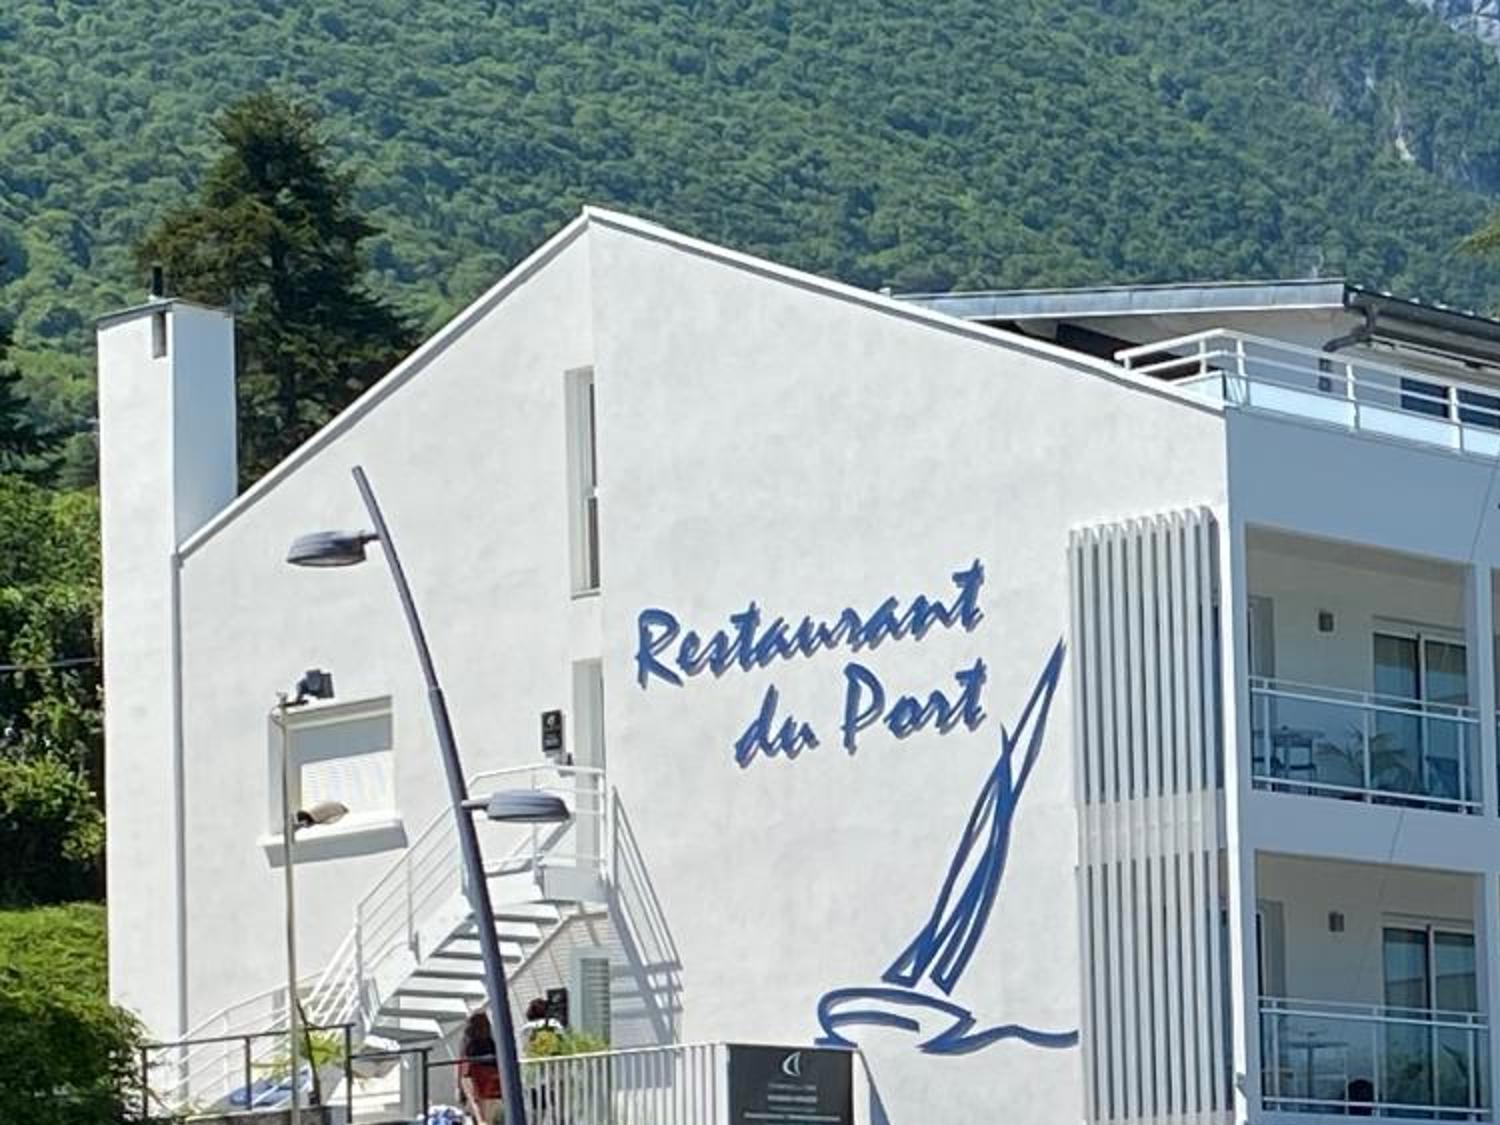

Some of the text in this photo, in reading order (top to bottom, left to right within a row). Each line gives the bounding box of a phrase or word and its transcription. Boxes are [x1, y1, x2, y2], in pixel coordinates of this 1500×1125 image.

[636, 558, 985, 688] Restaurant
[735, 657, 987, 768] du Port
